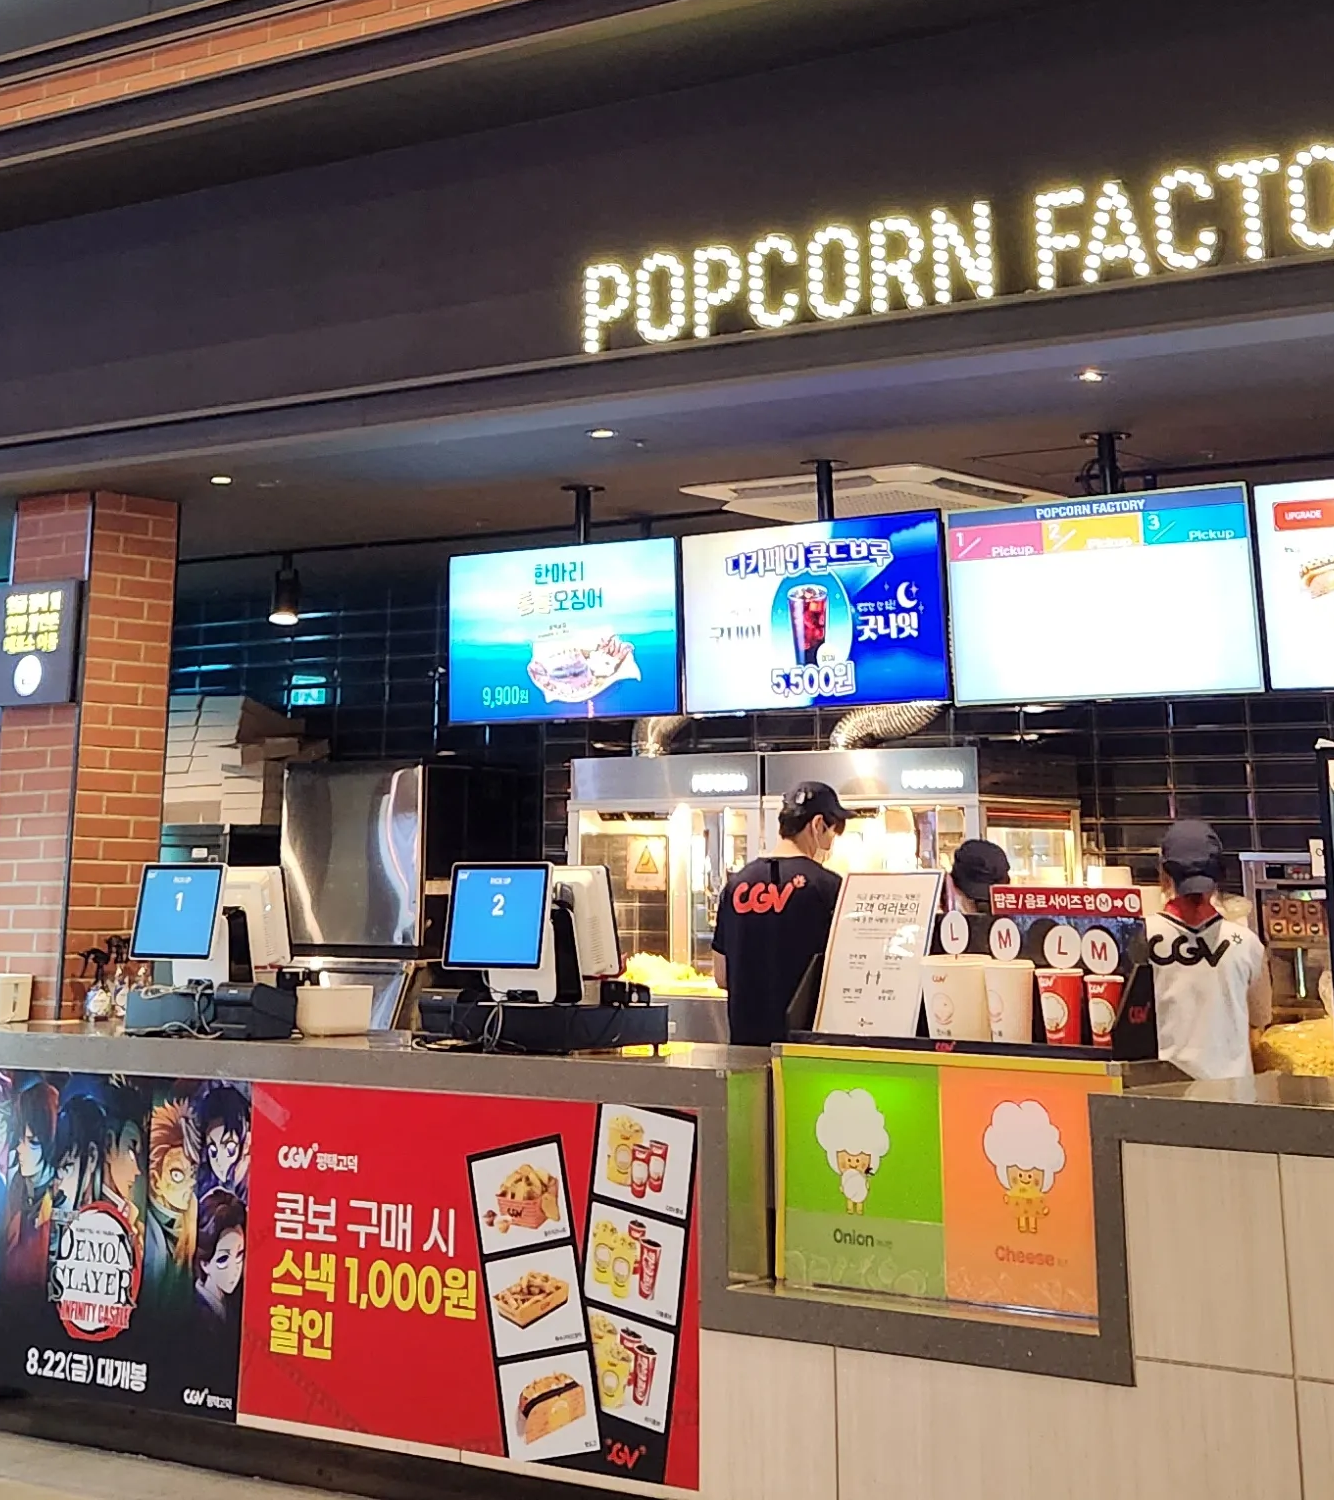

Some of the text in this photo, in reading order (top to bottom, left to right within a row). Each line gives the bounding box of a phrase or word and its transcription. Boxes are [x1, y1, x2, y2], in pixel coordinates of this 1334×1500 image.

[580, 197, 996, 355] POPCORN
[1036, 499, 1146, 519] POPCORN FACTORY
[1284, 510, 1322, 521] UPGRADE
[1147, 514, 1160, 530] 3
[956, 532, 964, 547] 1
[1188, 529, 1235, 540] Pickup
[725, 539, 893, 579] 디카페인 콜드브루
[991, 545, 1034, 558] Pickup
[535, 561, 584, 585] 한마리
[856, 612, 919, 641] 굿나잇
[771, 662, 855, 697] 5,500원
[482, 686, 529, 707] 9,900원
[175, 892, 184, 912] 1
[491, 893, 505, 916] 2
[732, 881, 795, 915] CGV
[854, 902, 920, 915] 고객 여러분의
[994, 893, 1017, 908] 팝콘
[1025, 893, 1048, 908] 음료
[1050, 893, 1083, 909] 사이즈
[1085, 894, 1096, 909] 업
[950, 923, 959, 941] L
[997, 929, 1012, 949] M
[1057, 936, 1068, 955] L
[1091, 940, 1107, 962] M
[1148, 933, 1231, 967] CGV
[278, 1145, 314, 1169] CGV
[274, 1191, 456, 1258] 콤보 구매 시
[56, 1224, 134, 1266] DEMON
[833, 1228, 875, 1247] Onion
[995, 1245, 1055, 1267] Cheese
[50, 1264, 136, 1308] SLAYER
[271, 1250, 477, 1320] 스낵 1,000원
[61, 1301, 130, 1328] INFINITY CASTLE
[269, 1304, 333, 1360] 할인
[26, 1347, 147, 1392] 8.22(금) 대개봉
[183, 1388, 205, 1405] CGV
